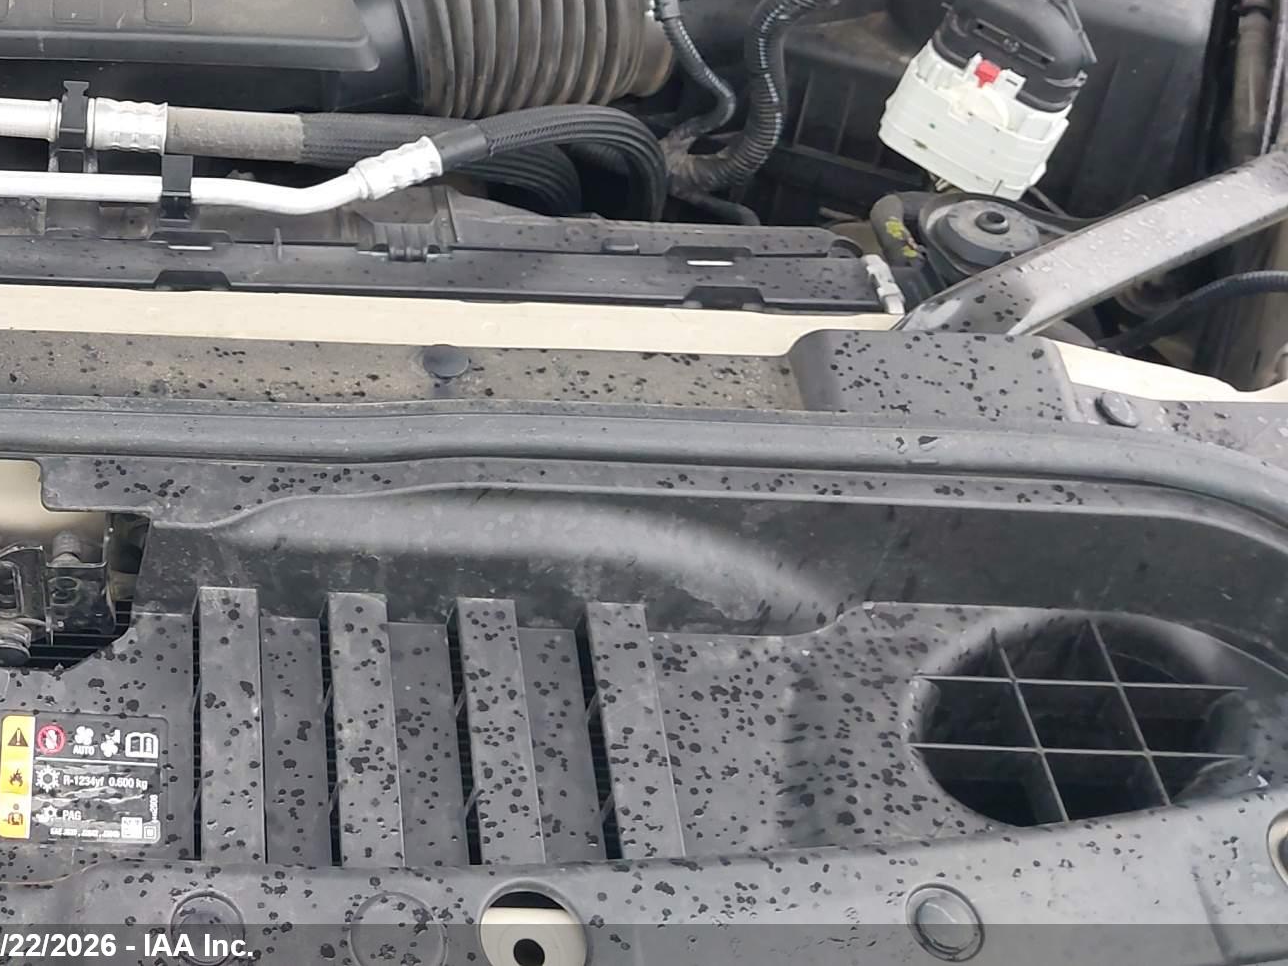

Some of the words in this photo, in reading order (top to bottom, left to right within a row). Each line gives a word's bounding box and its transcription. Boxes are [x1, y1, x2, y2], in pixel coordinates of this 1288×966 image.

[72, 746, 95, 756] AUTO
[63, 774, 105, 789] R-1234yf
[108, 776, 135, 789] 0.600
[135, 777, 148, 791] kg
[62, 809, 82, 821] PAG
